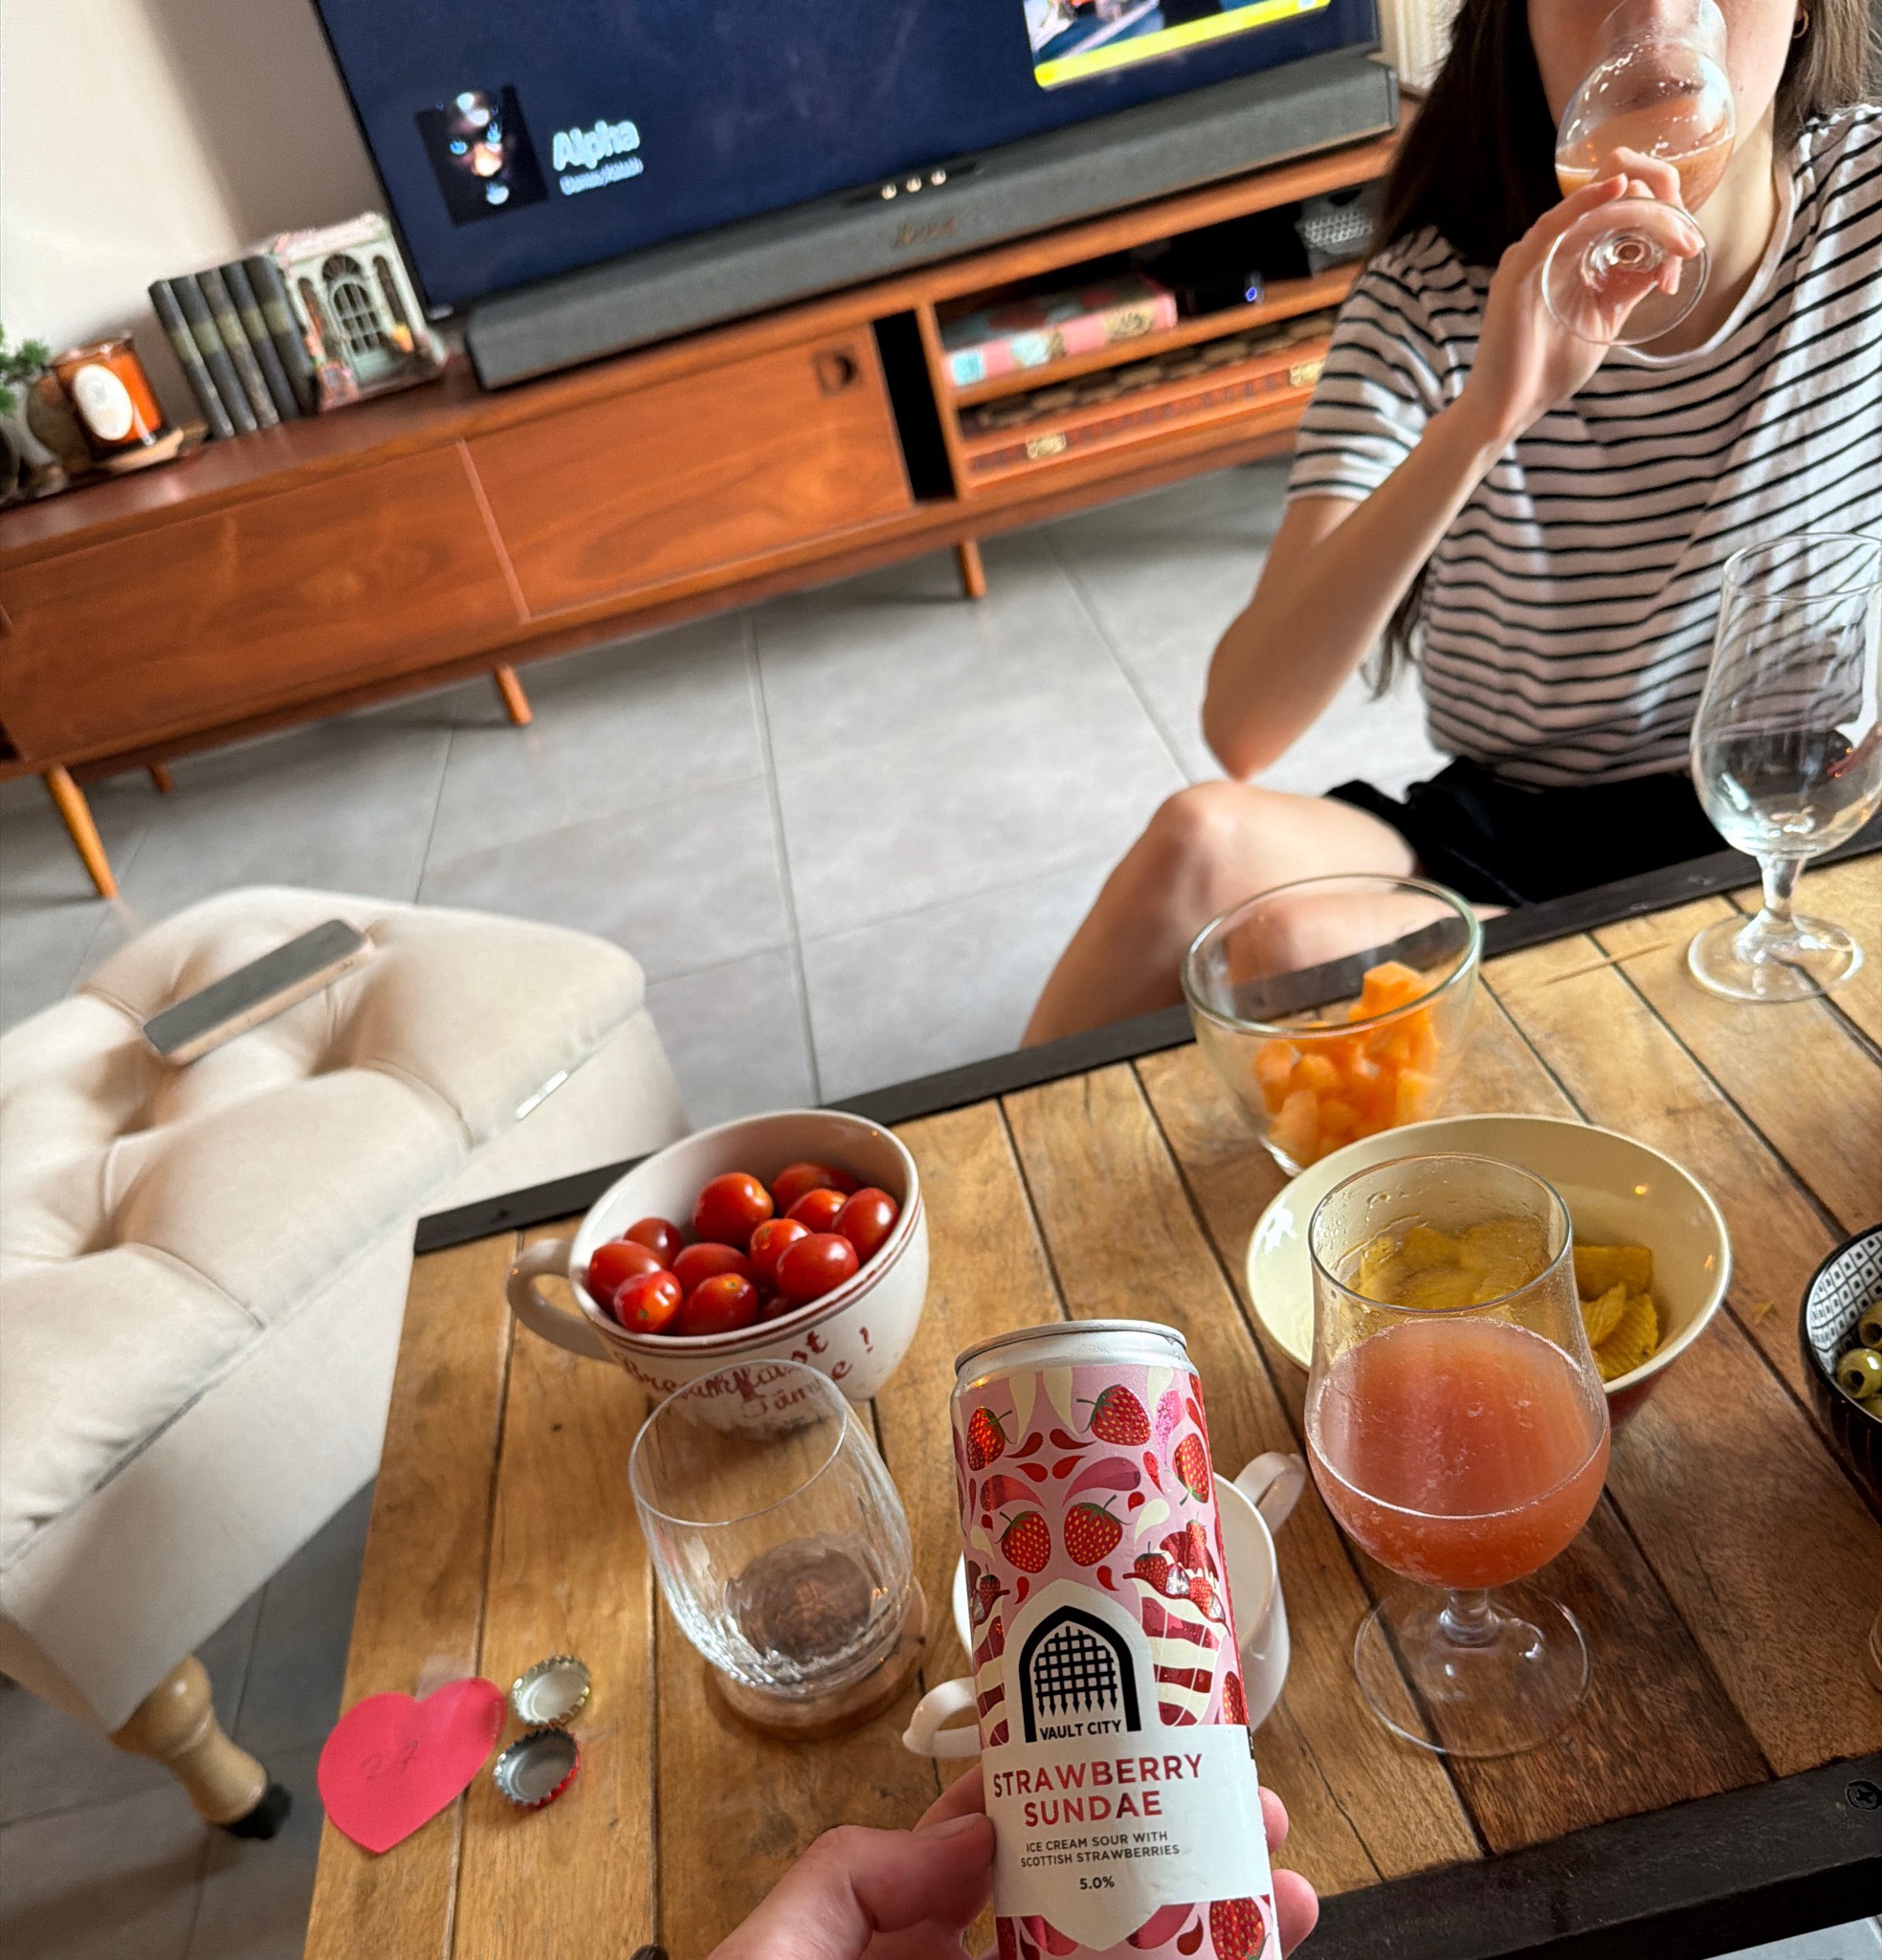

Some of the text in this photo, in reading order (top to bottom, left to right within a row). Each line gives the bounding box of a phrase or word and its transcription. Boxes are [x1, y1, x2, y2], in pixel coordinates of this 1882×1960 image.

[553, 120, 640, 171] Alpha
[1039, 1719, 1122, 1741] VAULT CITY
[993, 1753, 1203, 1798] STRAWBERRY
[1024, 1791, 1163, 1827] SUNDAE
[1026, 1830, 1168, 1853] ICE CREAM SOUR WITH
[1020, 1843, 1181, 1868] SCOTTISH STRAWBERRIES
[1079, 1875, 1116, 1891] 5.0%
